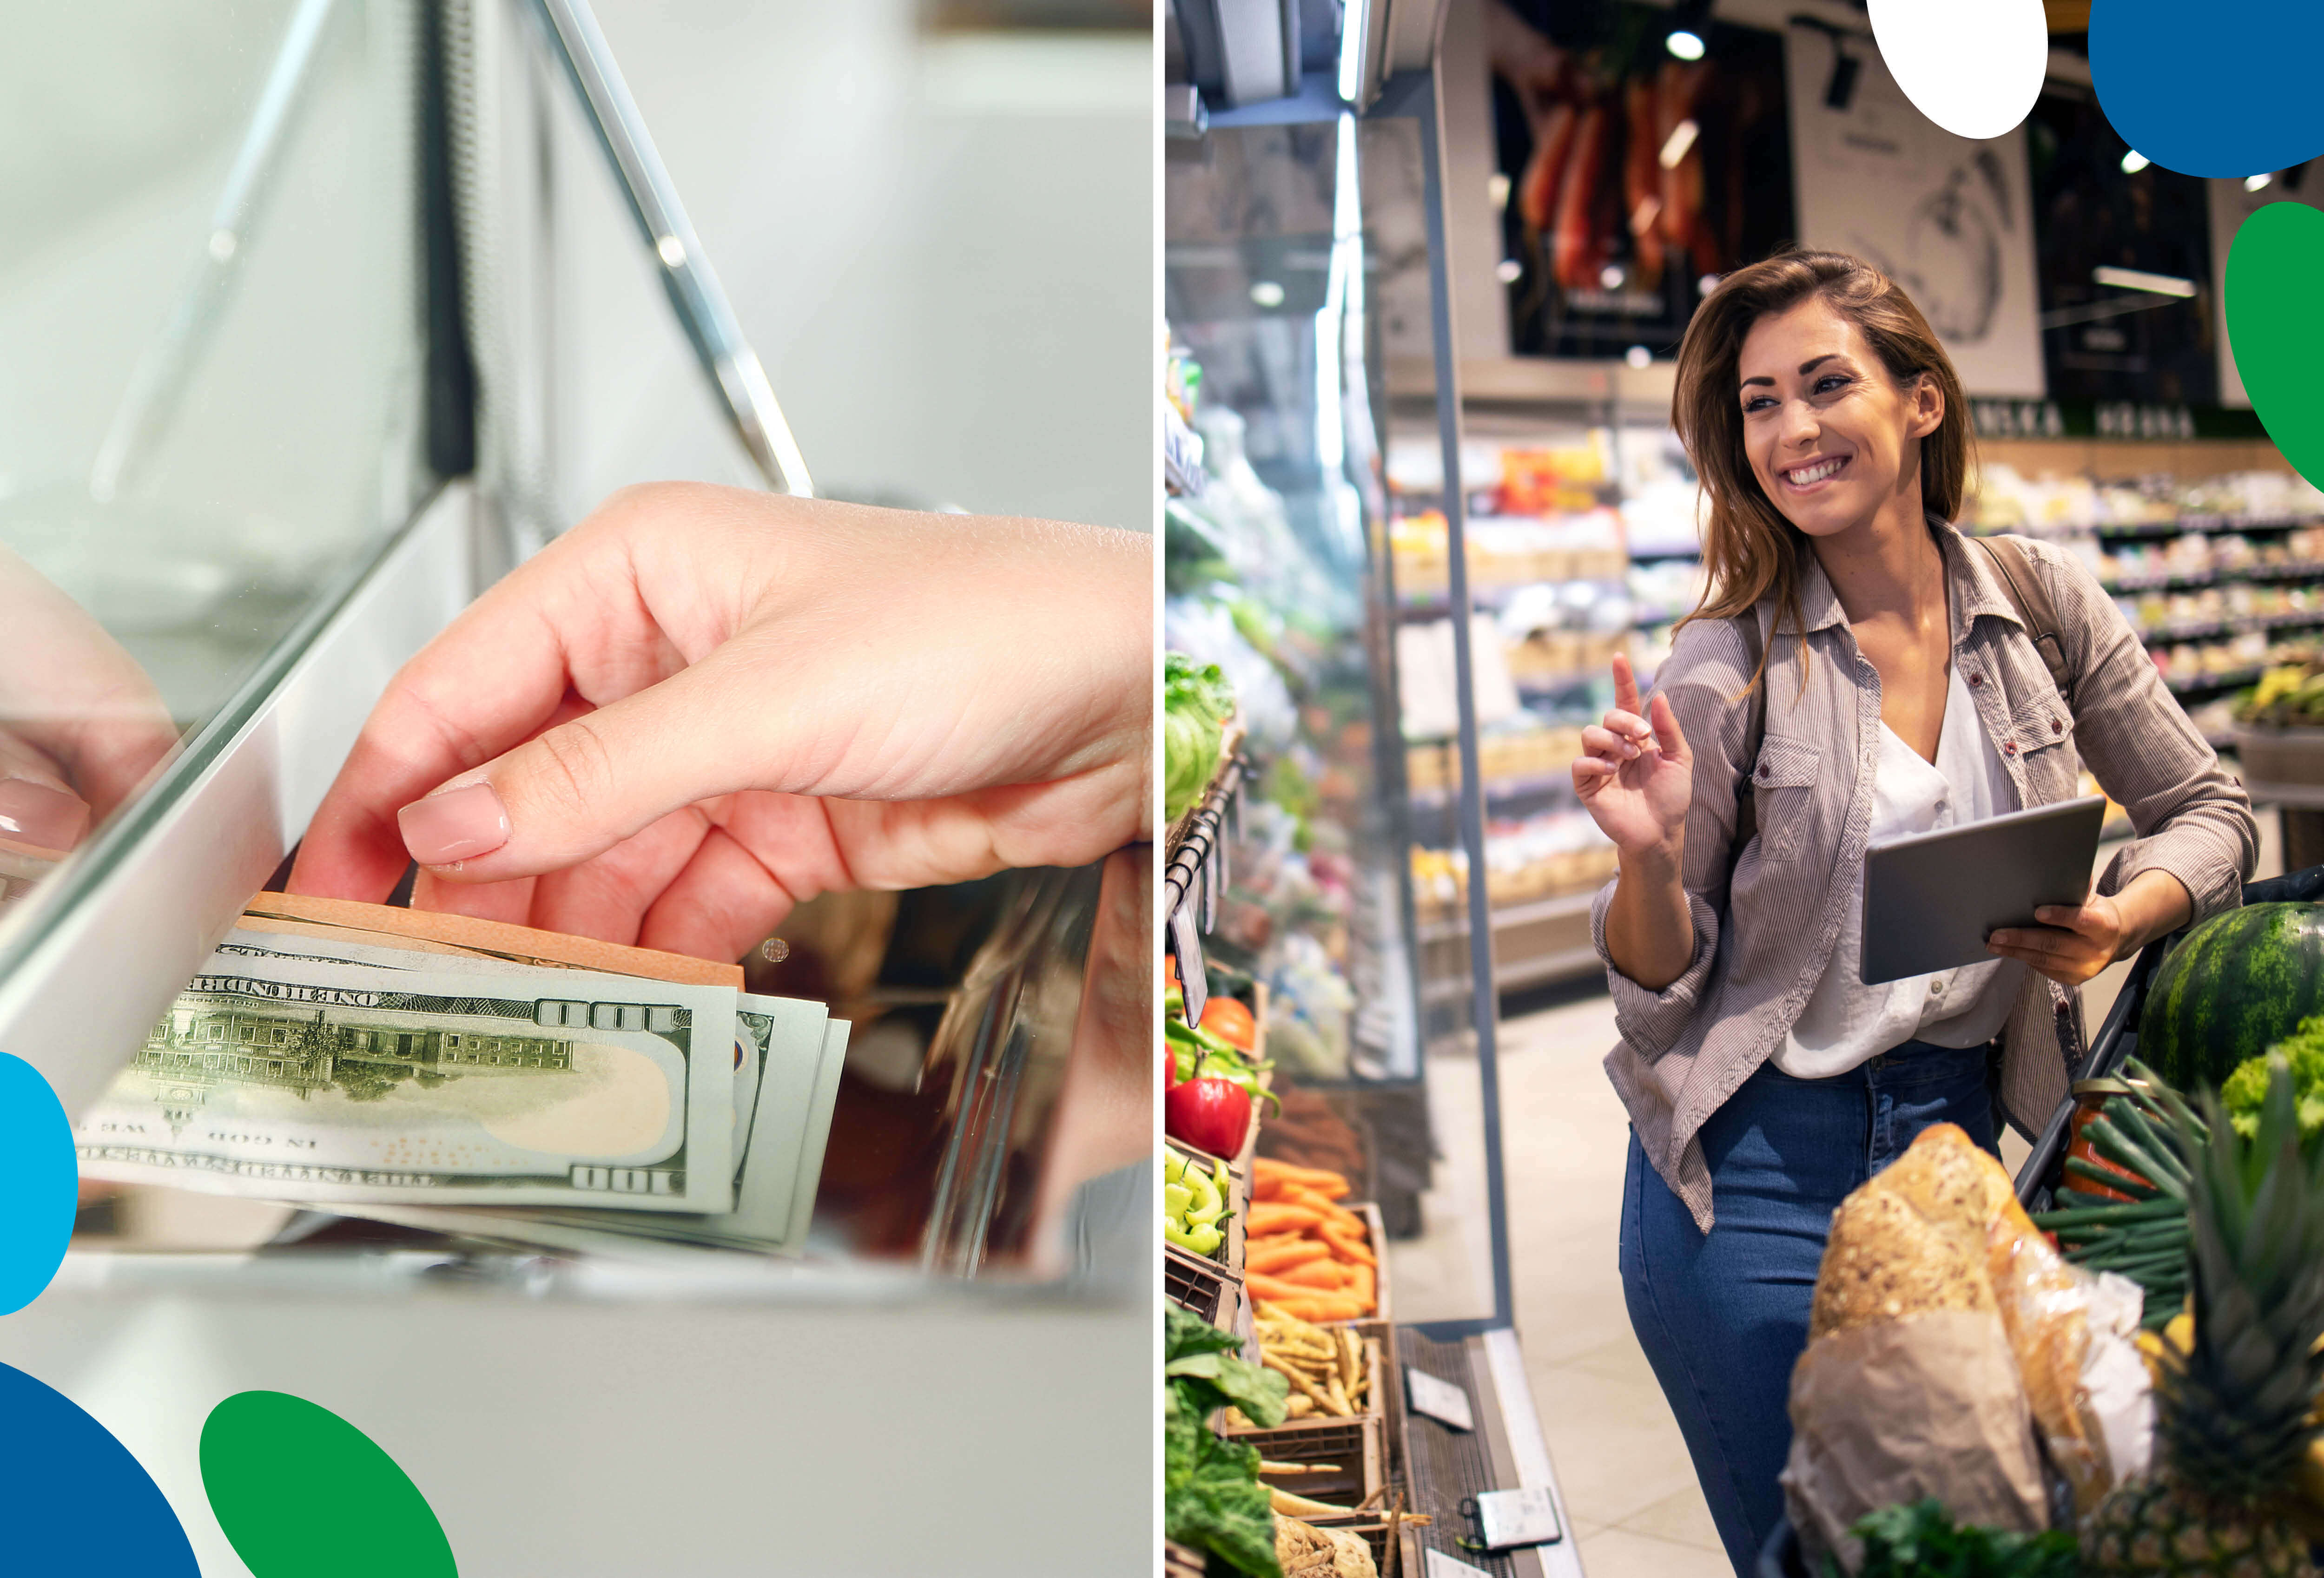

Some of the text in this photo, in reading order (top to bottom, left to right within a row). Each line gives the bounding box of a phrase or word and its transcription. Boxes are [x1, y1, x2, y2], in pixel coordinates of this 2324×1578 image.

[187, 977, 380, 1007] ONE HUNDRE
[178, 996, 259, 1008] INDEPENDEN
[533, 998, 683, 1033] 100
[99, 1122, 146, 1134] WE
[208, 1131, 273, 1146] GOD
[286, 1137, 317, 1150] IN
[568, 1164, 673, 1195] 100
